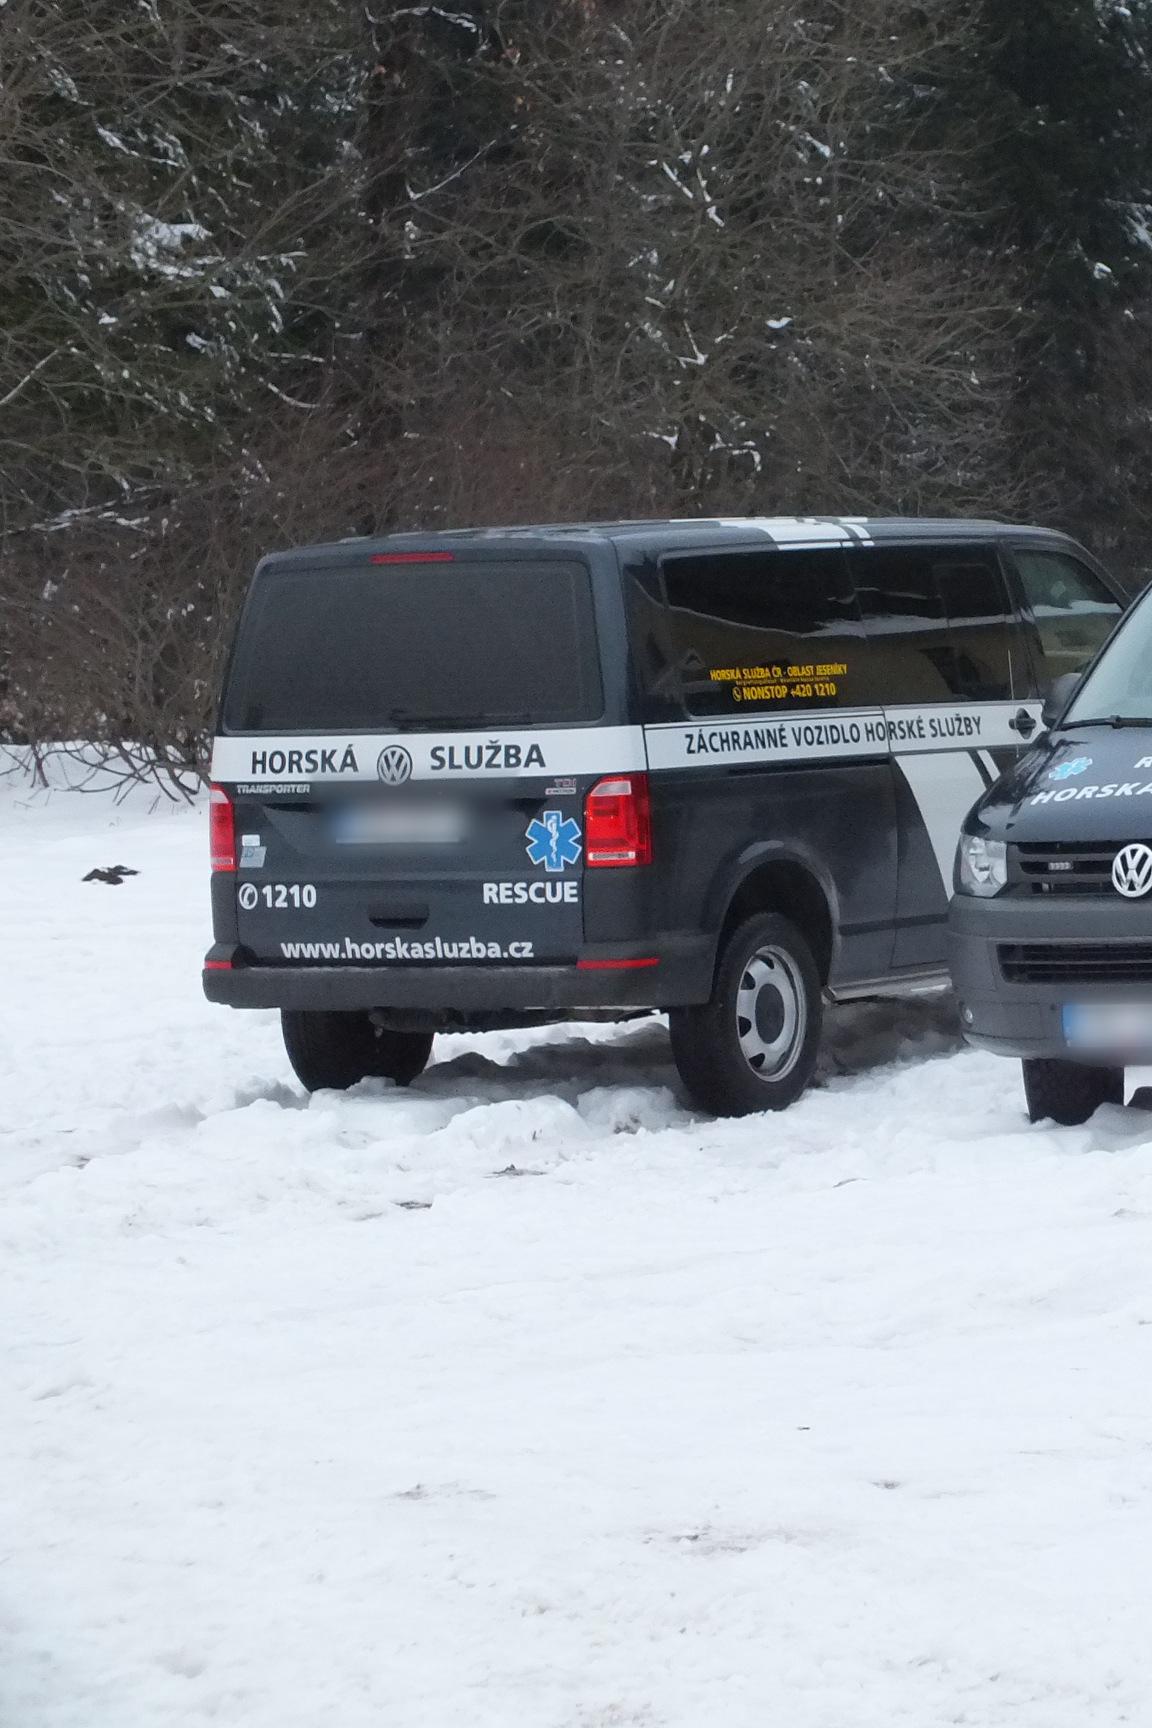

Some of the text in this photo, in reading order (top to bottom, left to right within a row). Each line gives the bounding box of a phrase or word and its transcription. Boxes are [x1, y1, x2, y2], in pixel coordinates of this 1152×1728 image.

[709, 667, 741, 681] HORSKÁ
[742, 665, 770, 679] SLUŽBA
[787, 664, 814, 676] OBLAST
[743, 683, 836, 700] NONSTOP +420 1210
[685, 713, 982, 755] ZÁCHRANNÉ VOZIDLO HORSKÉ SLUŽBY
[251, 739, 546, 775] HORSKÁ SLUŽBA
[236, 784, 311, 794] TRANSPORTER
[262, 884, 317, 909] 1210
[483, 881, 578, 904] RESCUE
[281, 936, 534, 960] www.horskasluzba.cz
